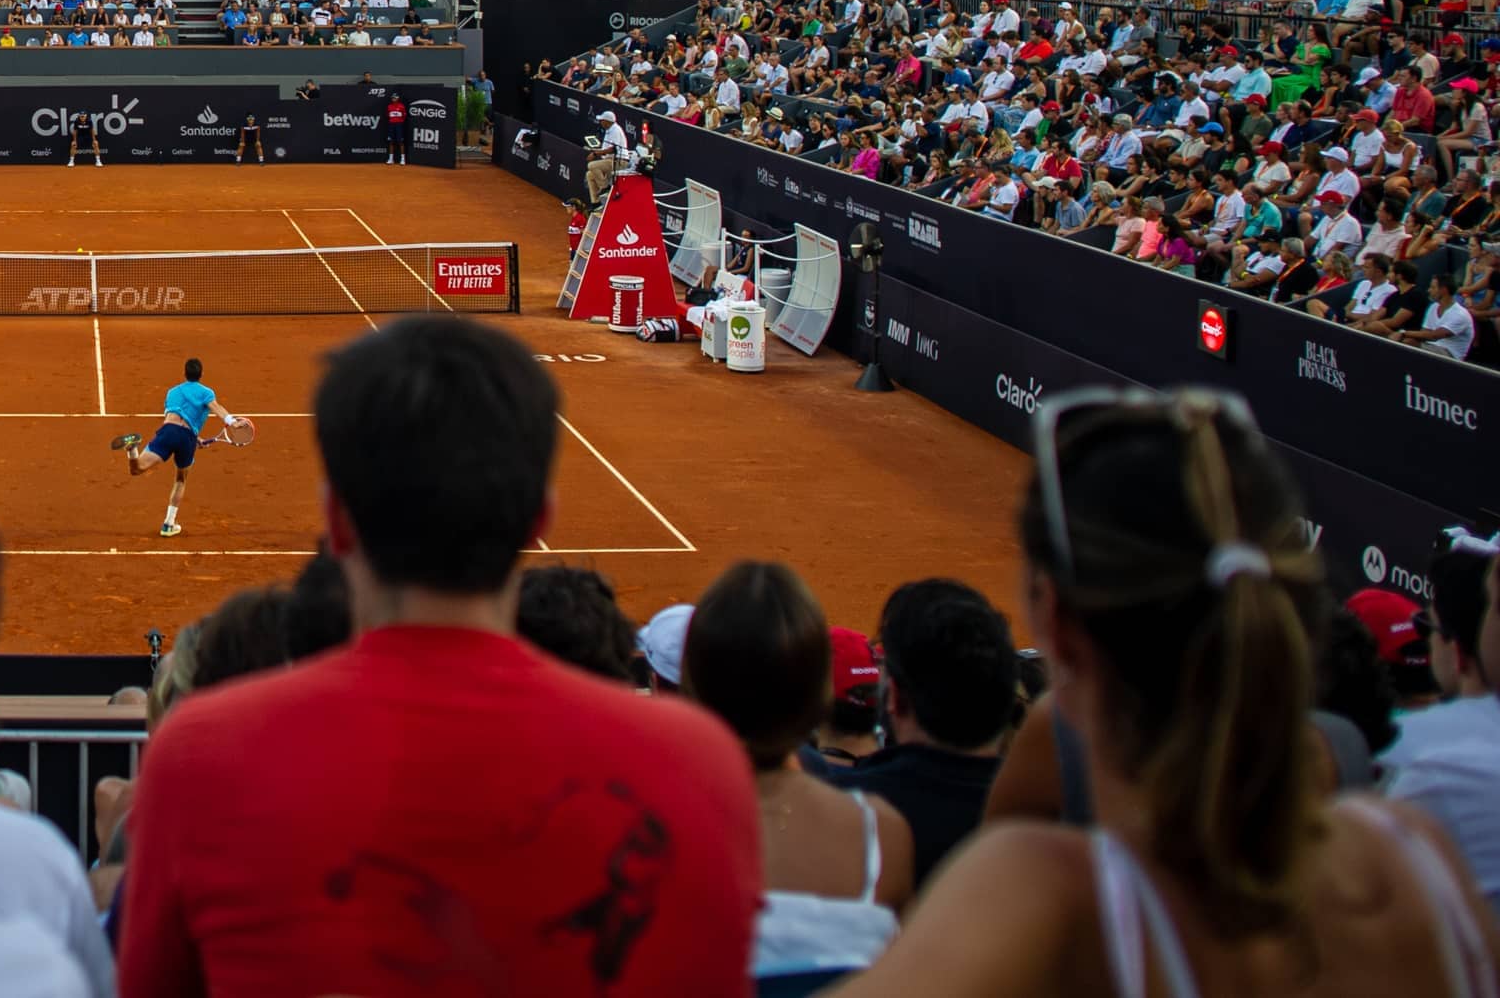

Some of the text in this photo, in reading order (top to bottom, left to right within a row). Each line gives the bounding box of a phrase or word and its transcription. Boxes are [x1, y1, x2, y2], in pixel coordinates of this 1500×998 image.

[323, 113, 380, 129] betway
[180, 126, 237, 137] Santander
[413, 128, 440, 144] HDI
[598, 246, 658, 259] Santander
[438, 262, 502, 276] Emirates
[447, 277, 493, 289] FLY BETTER
[20, 287, 185, 311] ATP TOUR
[612, 289, 622, 325] Wilson
[887, 318, 911, 346] IMM
[1306, 340, 1337, 369] BLACK
[996, 373, 1035, 414] Claro
[1404, 374, 1477, 430] ibmec
